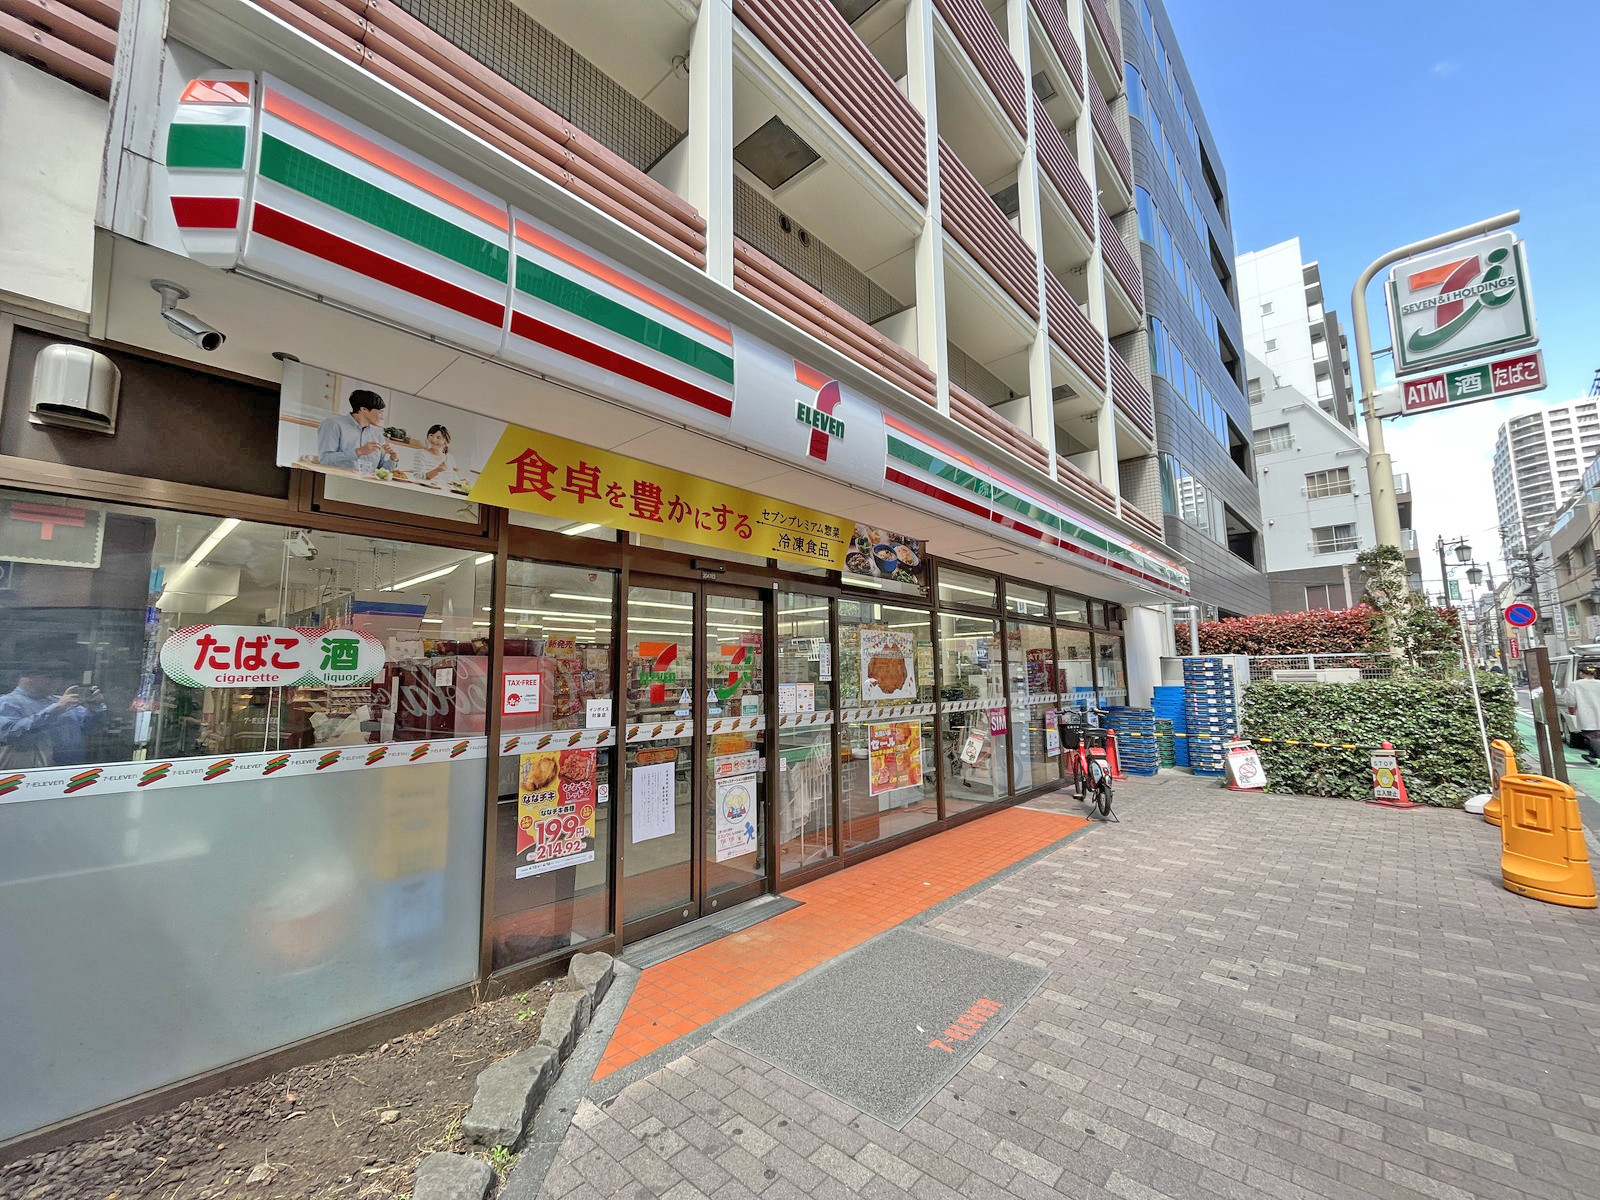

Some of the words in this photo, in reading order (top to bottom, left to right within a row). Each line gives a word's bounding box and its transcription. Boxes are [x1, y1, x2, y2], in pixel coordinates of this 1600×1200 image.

[1453, 275, 1516, 300] HOLDINGS
[1454, 372, 1482, 396] 酒
[1494, 361, 1539, 387] たばこ
[1408, 380, 1445, 405] ATM
[505, 447, 753, 540] 食卓を豊かにする
[762, 508, 841, 539] セブンプレミアム惣菜
[778, 532, 830, 558] 冷凍食品
[193, 634, 300, 671] たばこ
[319, 637, 361, 671] 酒
[215, 673, 280, 685] cigarette
[323, 673, 359, 684] liquor
[507, 679, 538, 687] TAX-FREE
[991, 715, 1007, 731] SIM
[522, 791, 557, 804] ななチキ
